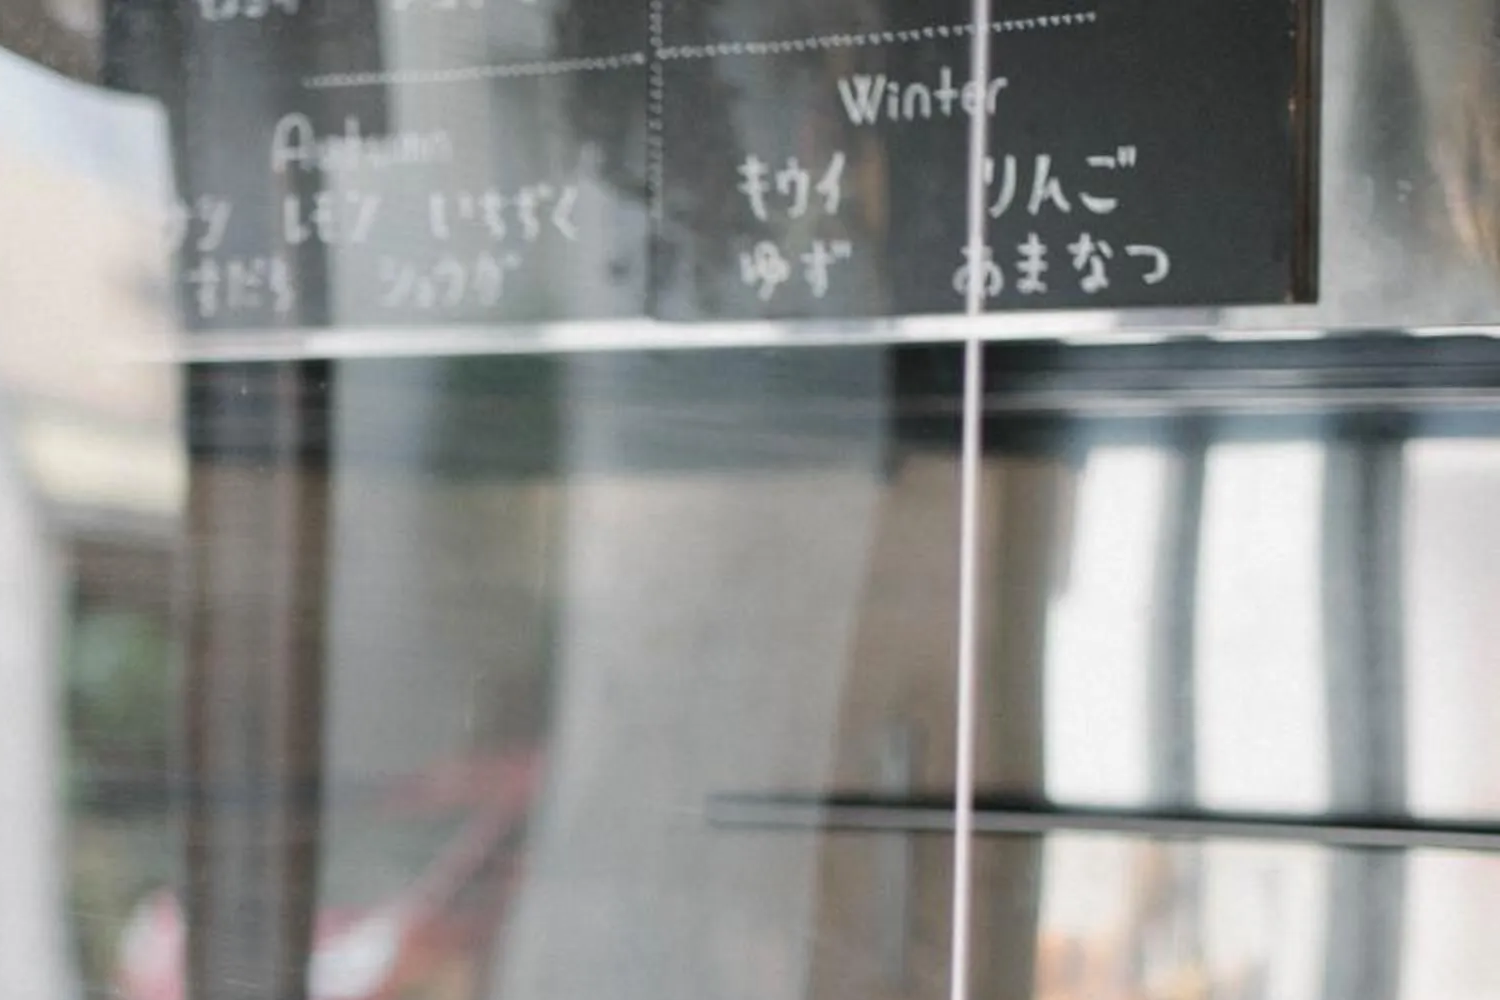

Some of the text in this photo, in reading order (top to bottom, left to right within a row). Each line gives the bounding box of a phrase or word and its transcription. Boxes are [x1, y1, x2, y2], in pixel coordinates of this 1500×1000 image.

[837, 66, 1008, 126] Winter
[737, 150, 845, 221] キウイ
[982, 145, 1137, 218] りんご
[739, 239, 852, 301] ゆず
[952, 231, 1171, 299] あまなつ
